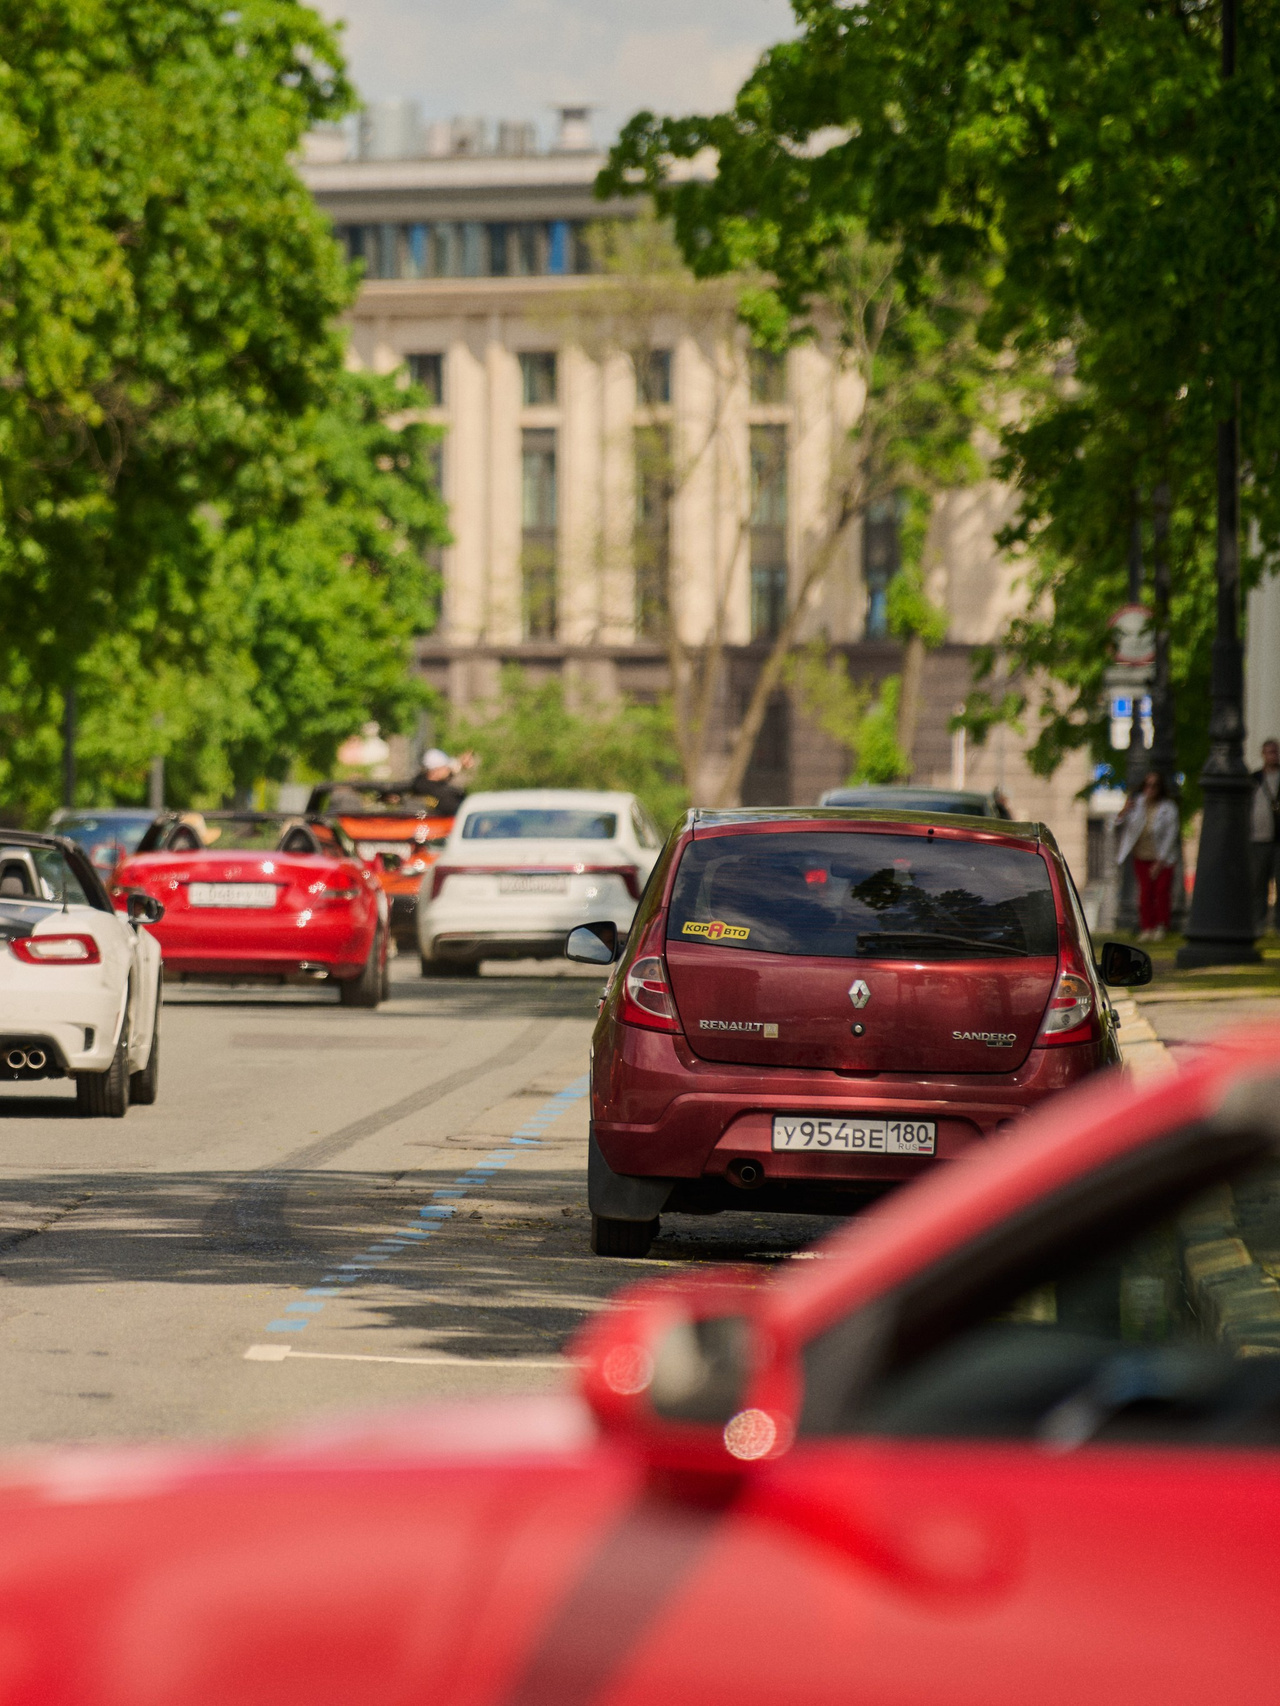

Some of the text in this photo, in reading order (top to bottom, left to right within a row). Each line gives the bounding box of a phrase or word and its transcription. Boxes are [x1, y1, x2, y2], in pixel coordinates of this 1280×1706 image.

[699, 1019, 763, 1032] RENAULT
[952, 1031, 1017, 1042] SANDERO
[783, 1121, 929, 1149] У954ВЕ 180
[898, 1143, 918, 1151] RUS
